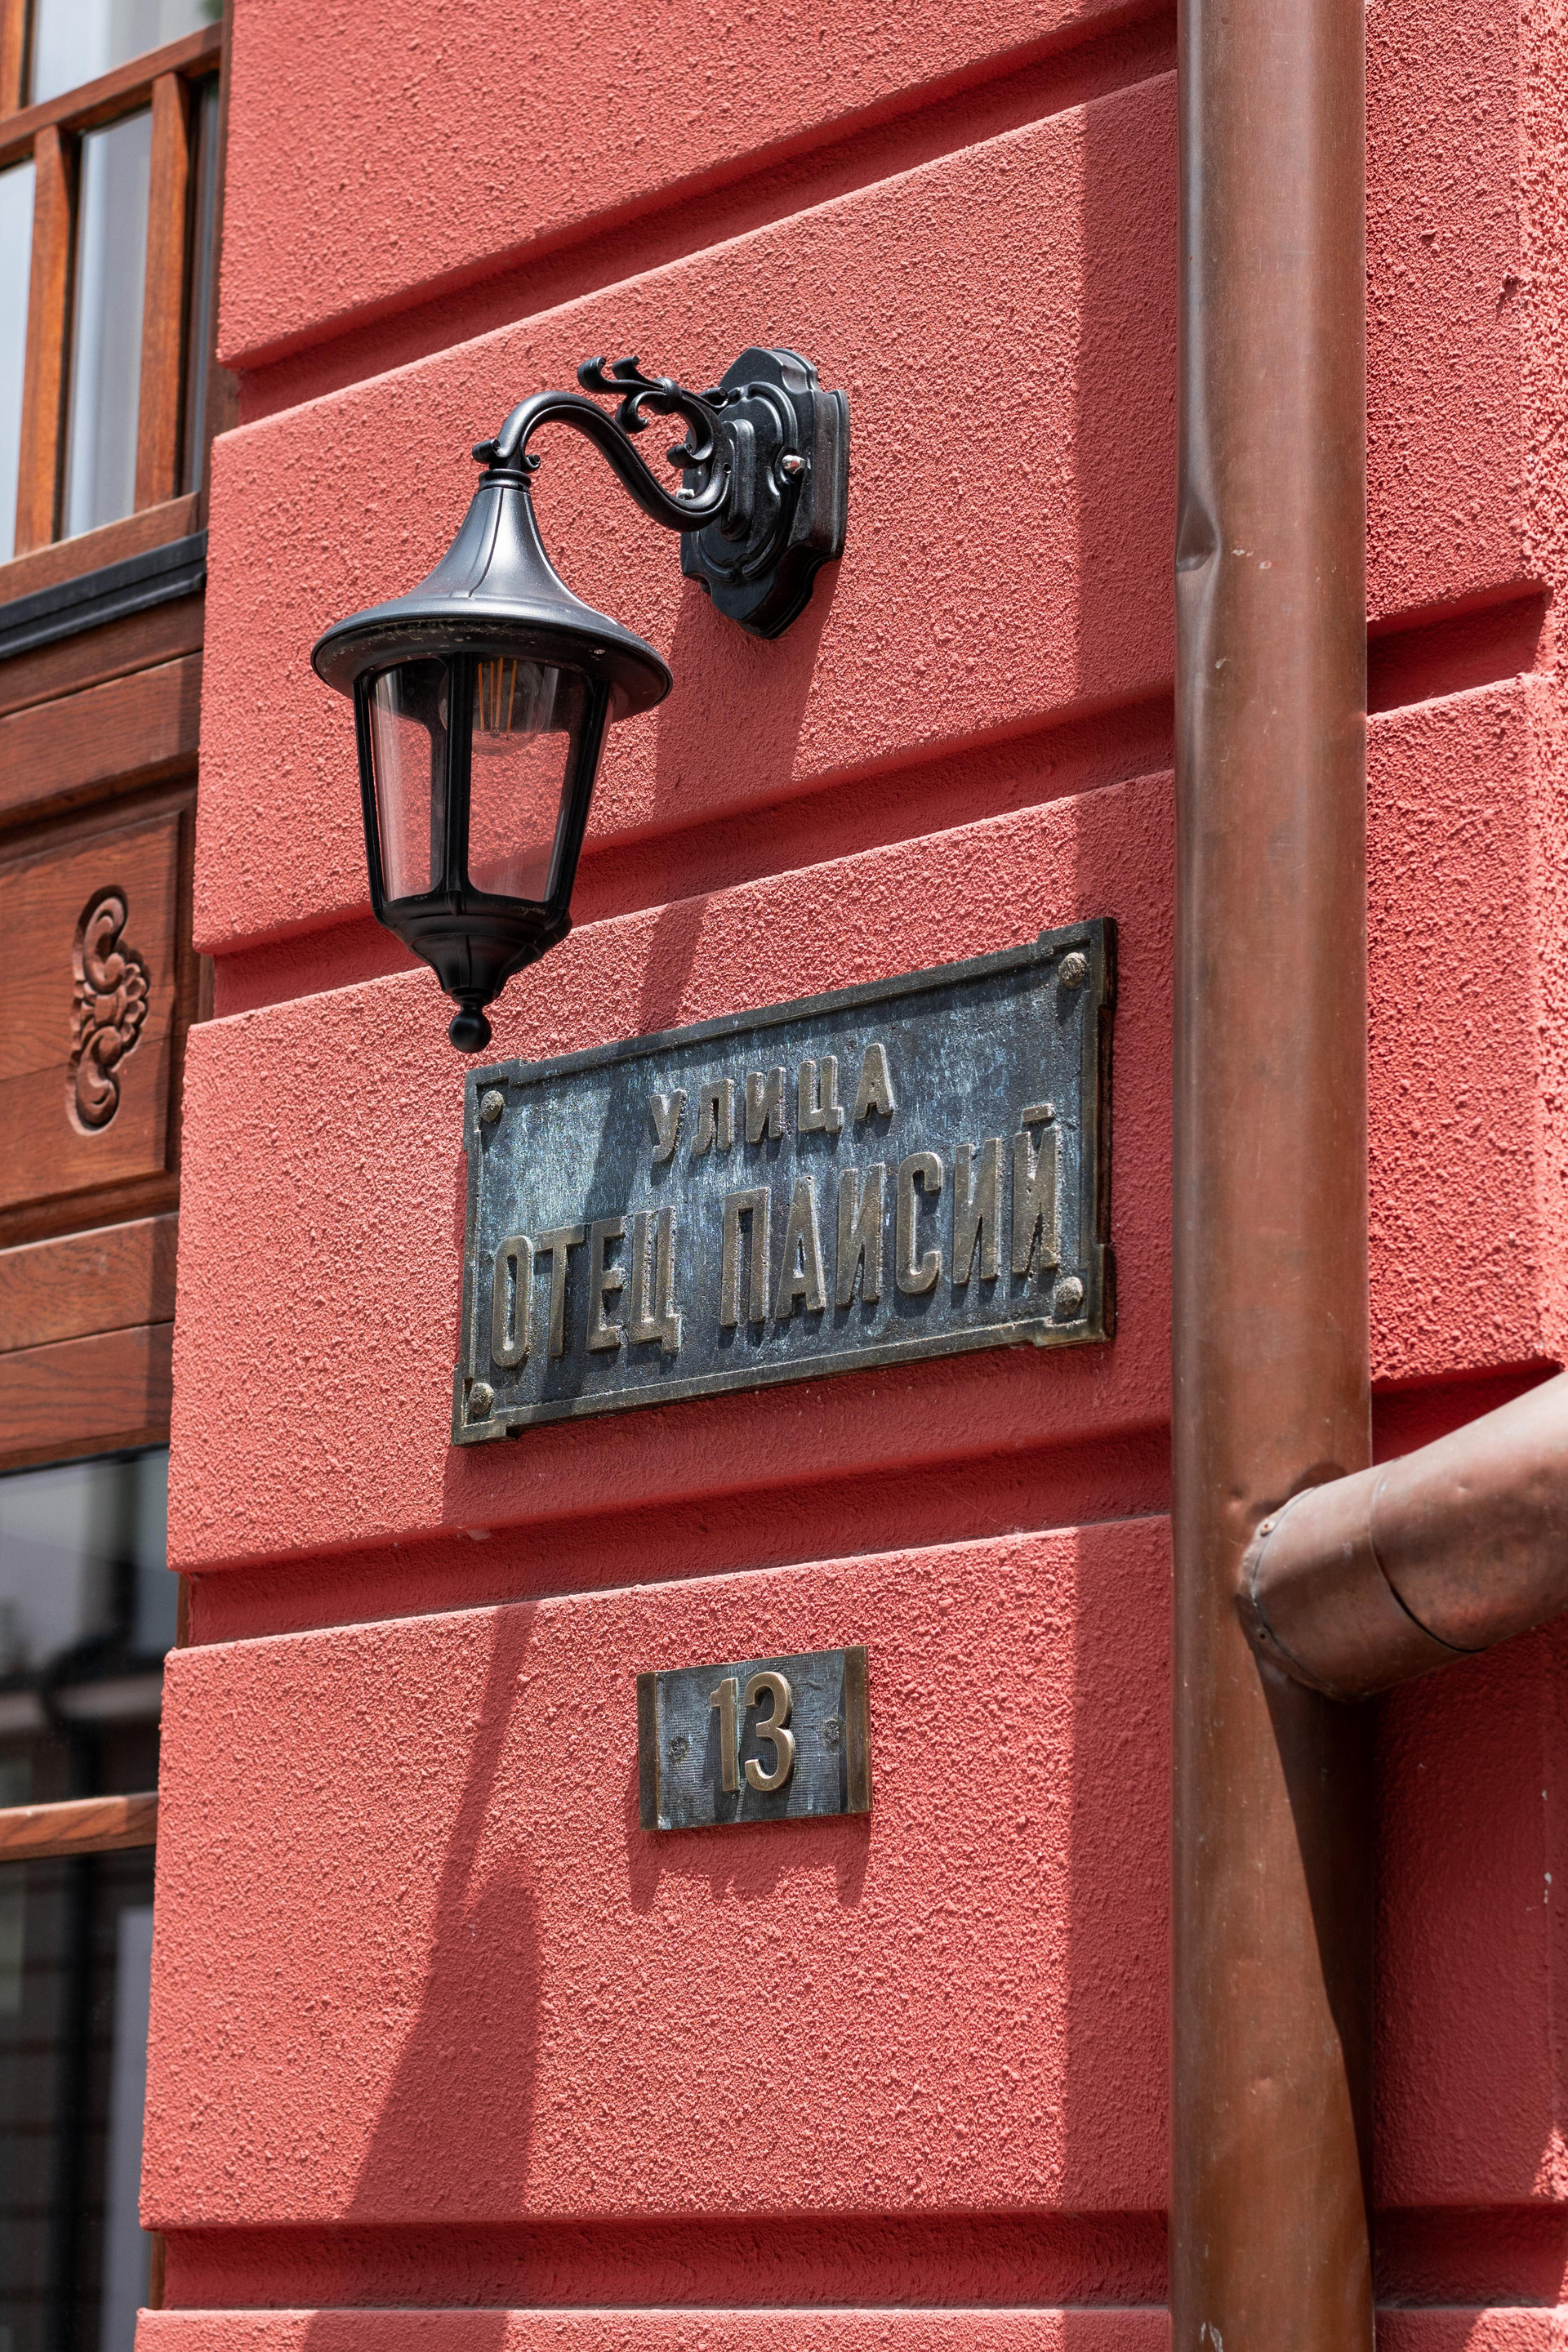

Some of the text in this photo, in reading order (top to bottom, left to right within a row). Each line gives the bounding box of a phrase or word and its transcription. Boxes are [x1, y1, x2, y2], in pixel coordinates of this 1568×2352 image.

[653, 1043, 896, 1164] УЛИЦА
[491, 1103, 1062, 1369] ОТЕЦ ПАИСИЙ
[710, 1671, 795, 1792] 13
